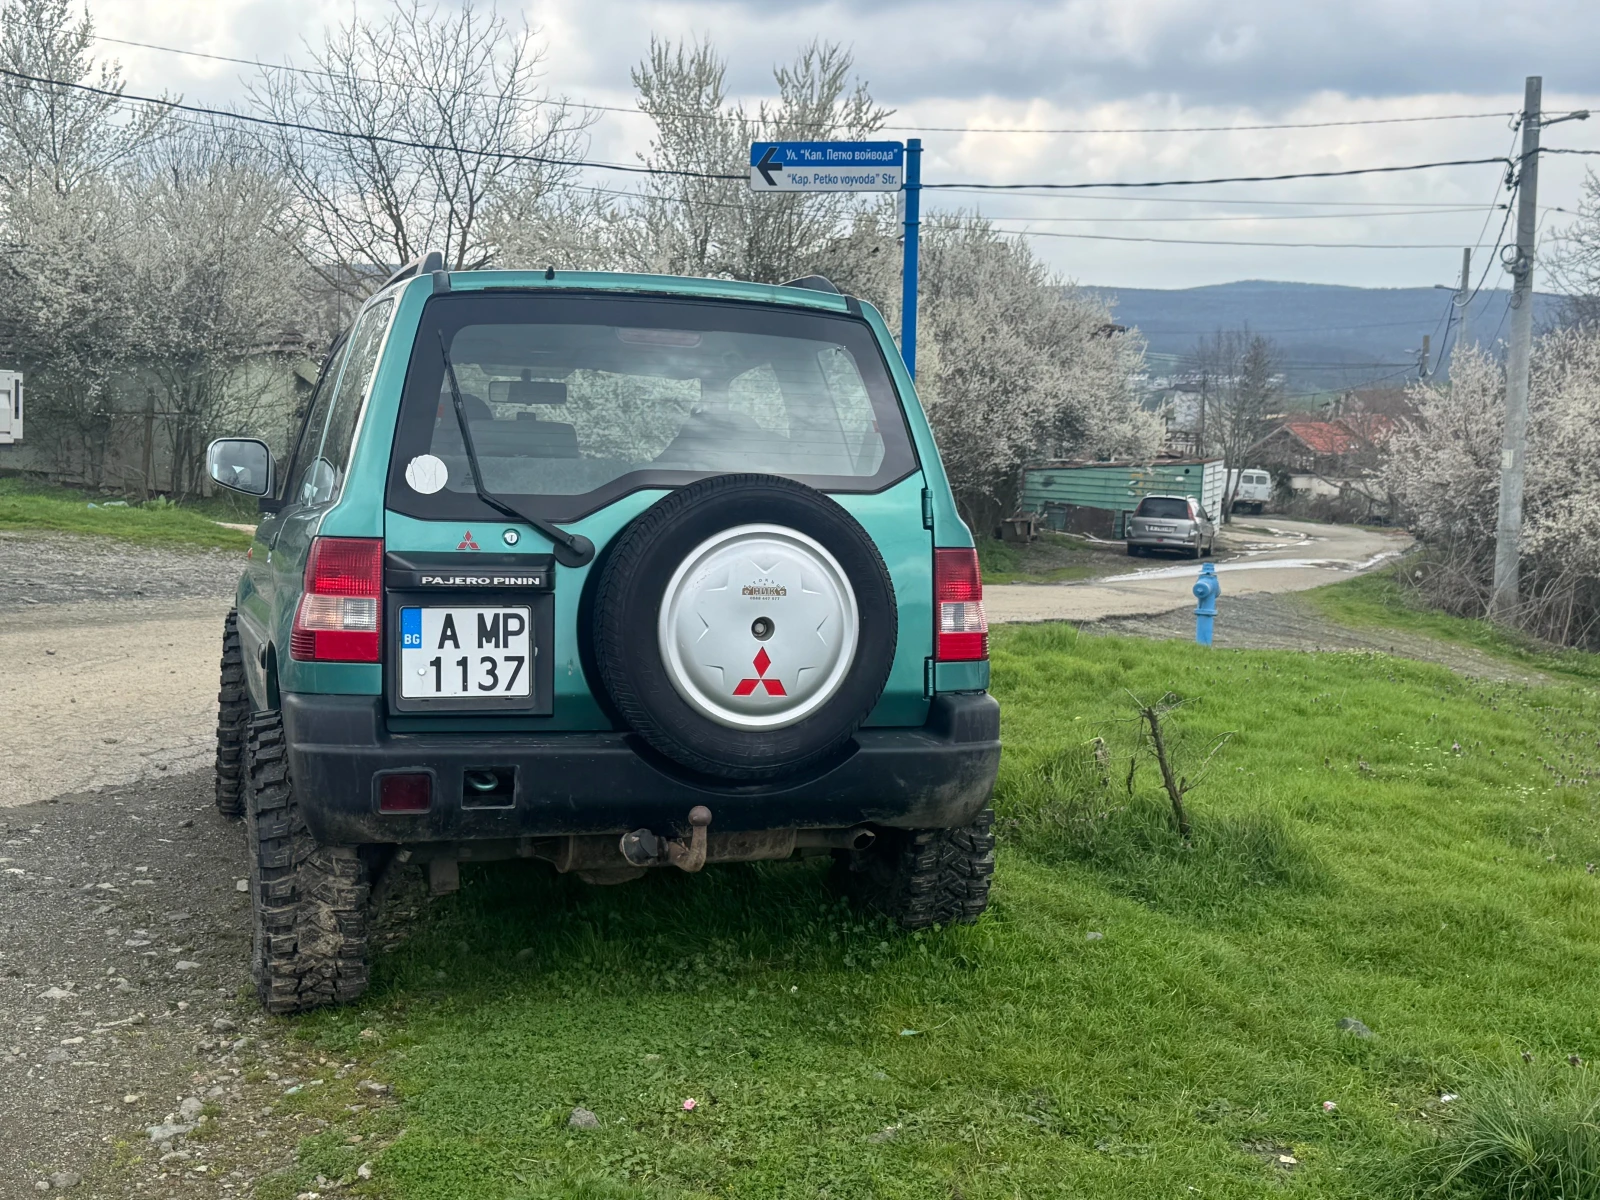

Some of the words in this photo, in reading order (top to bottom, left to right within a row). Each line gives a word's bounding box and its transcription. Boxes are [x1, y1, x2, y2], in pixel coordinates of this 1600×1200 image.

[786, 149, 798, 160] Ул.
[826, 149, 852, 160] Петко
[813, 173, 838, 184] Petko
[881, 173, 897, 184] Str.
[421, 576, 490, 585] PAJERO
[493, 577, 540, 585] PININ
[437, 613, 461, 650] A
[477, 612, 526, 649] MP
[404, 634, 420, 645] BG
[429, 655, 525, 693] 1137
